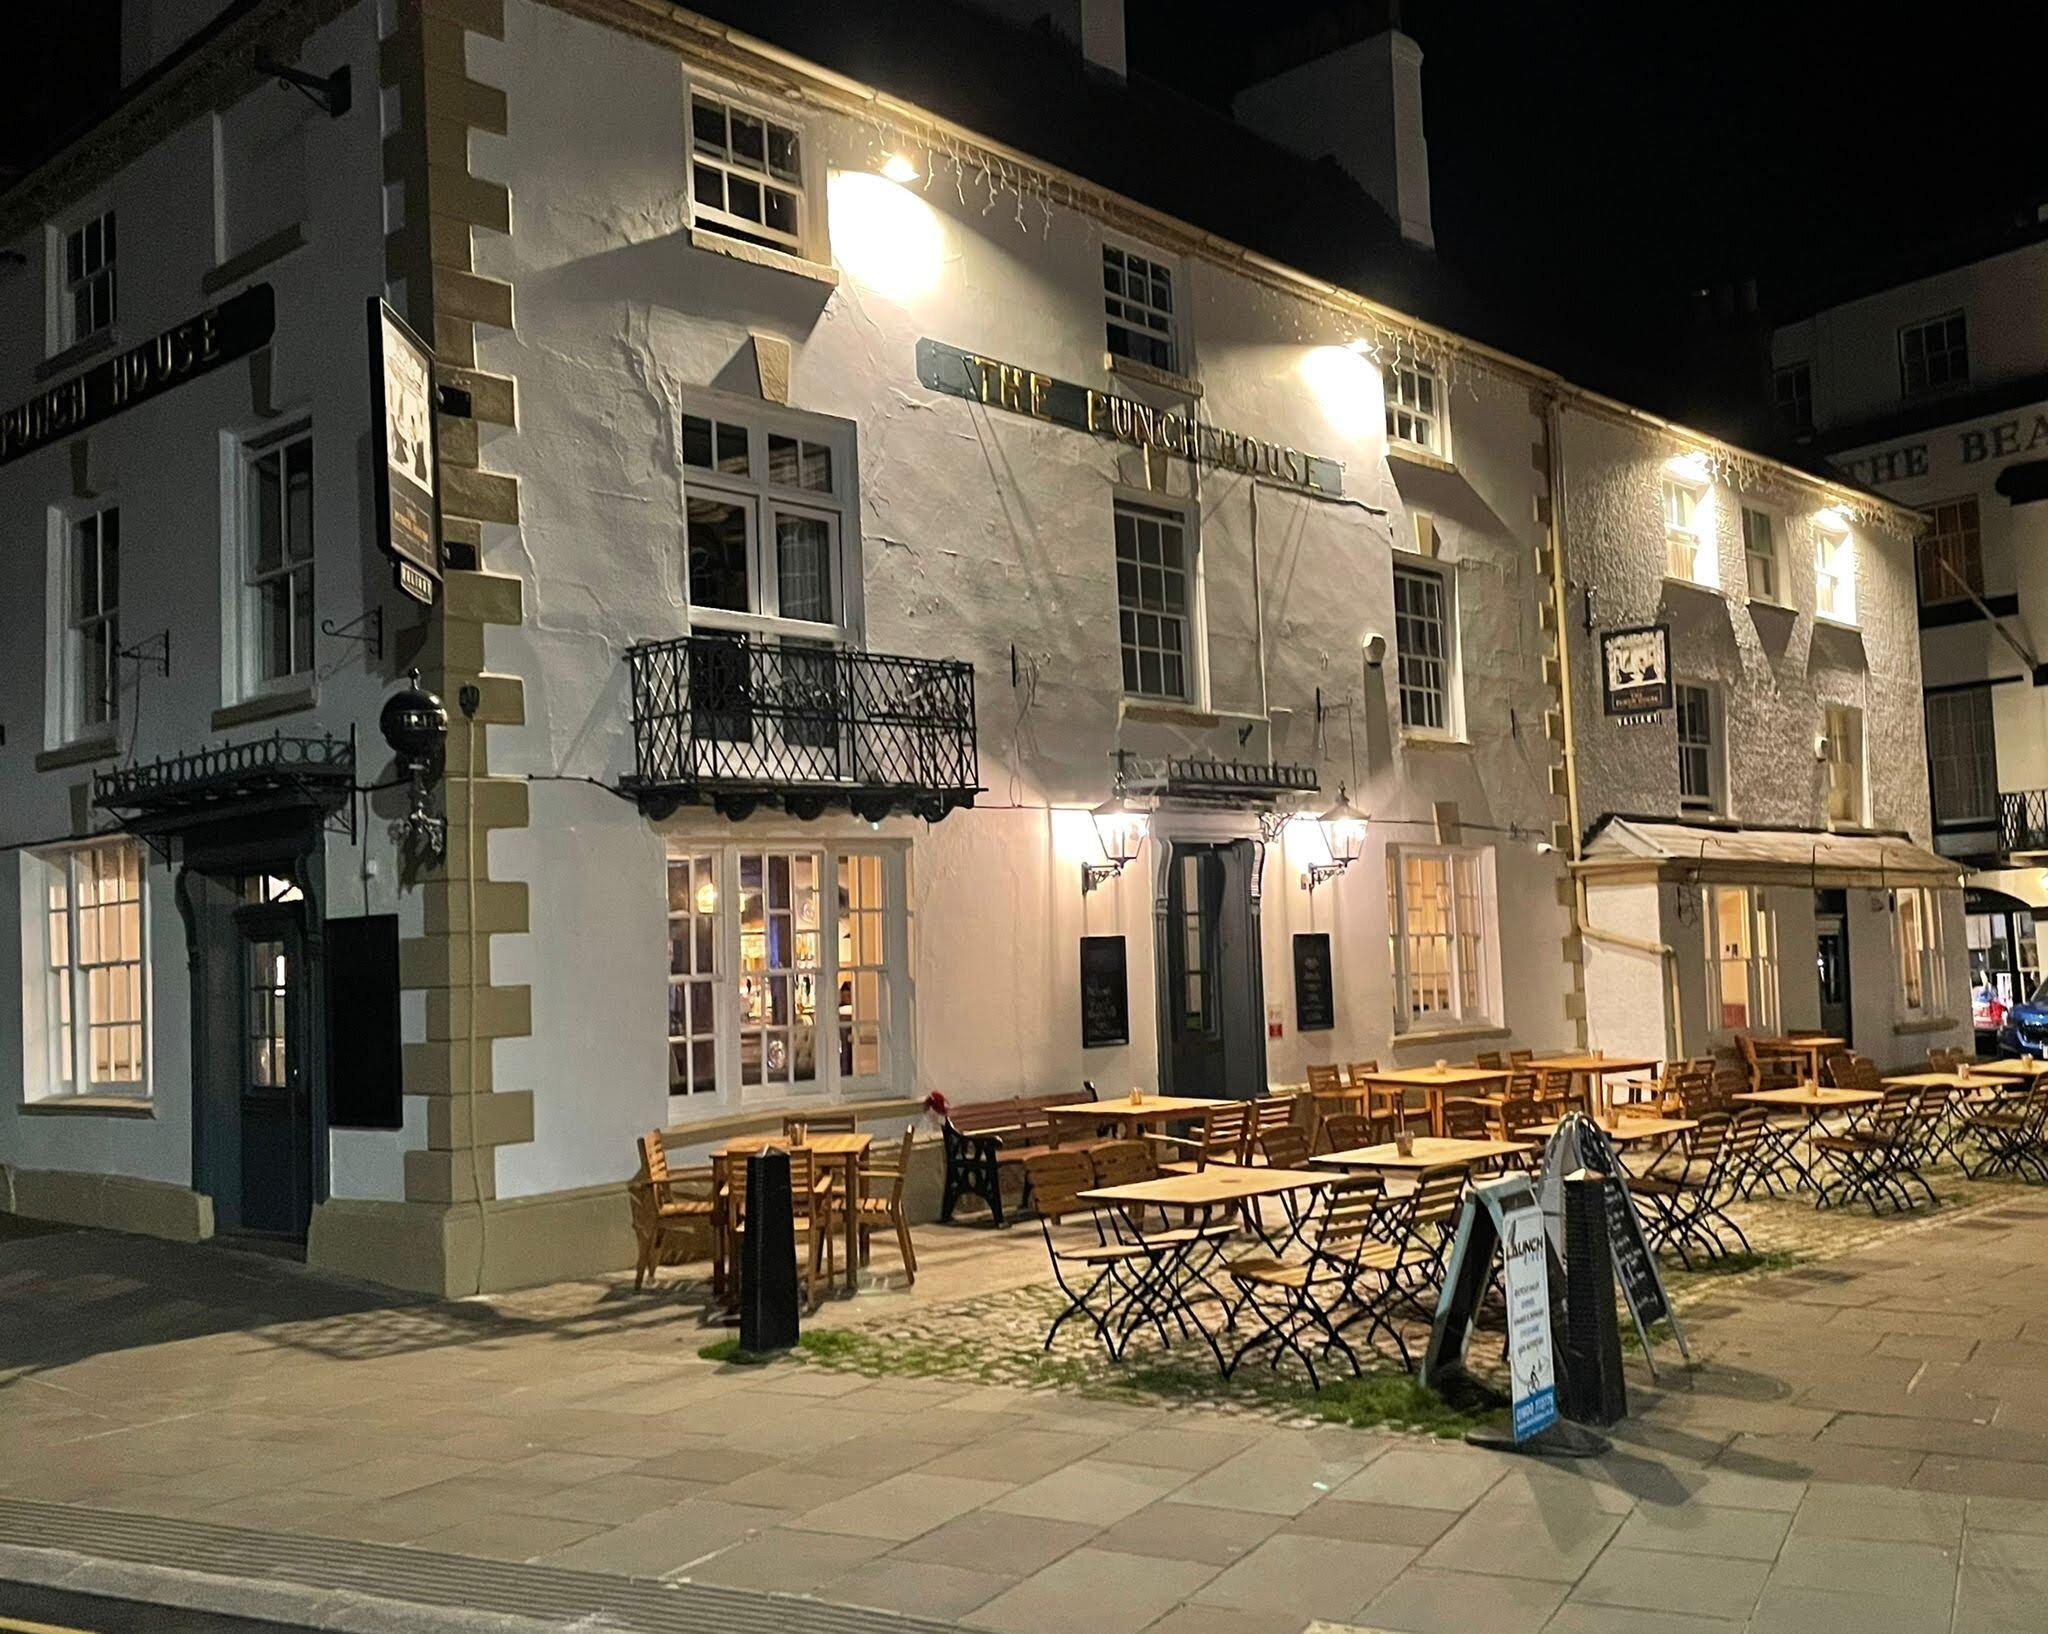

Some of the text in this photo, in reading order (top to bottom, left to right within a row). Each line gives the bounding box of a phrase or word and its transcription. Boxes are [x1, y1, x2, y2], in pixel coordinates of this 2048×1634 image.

[0, 308, 220, 456] PUNCH HOUSE
[972, 354, 1323, 490] THE PUNCH HOUSE
[1842, 443, 1930, 486] THE
